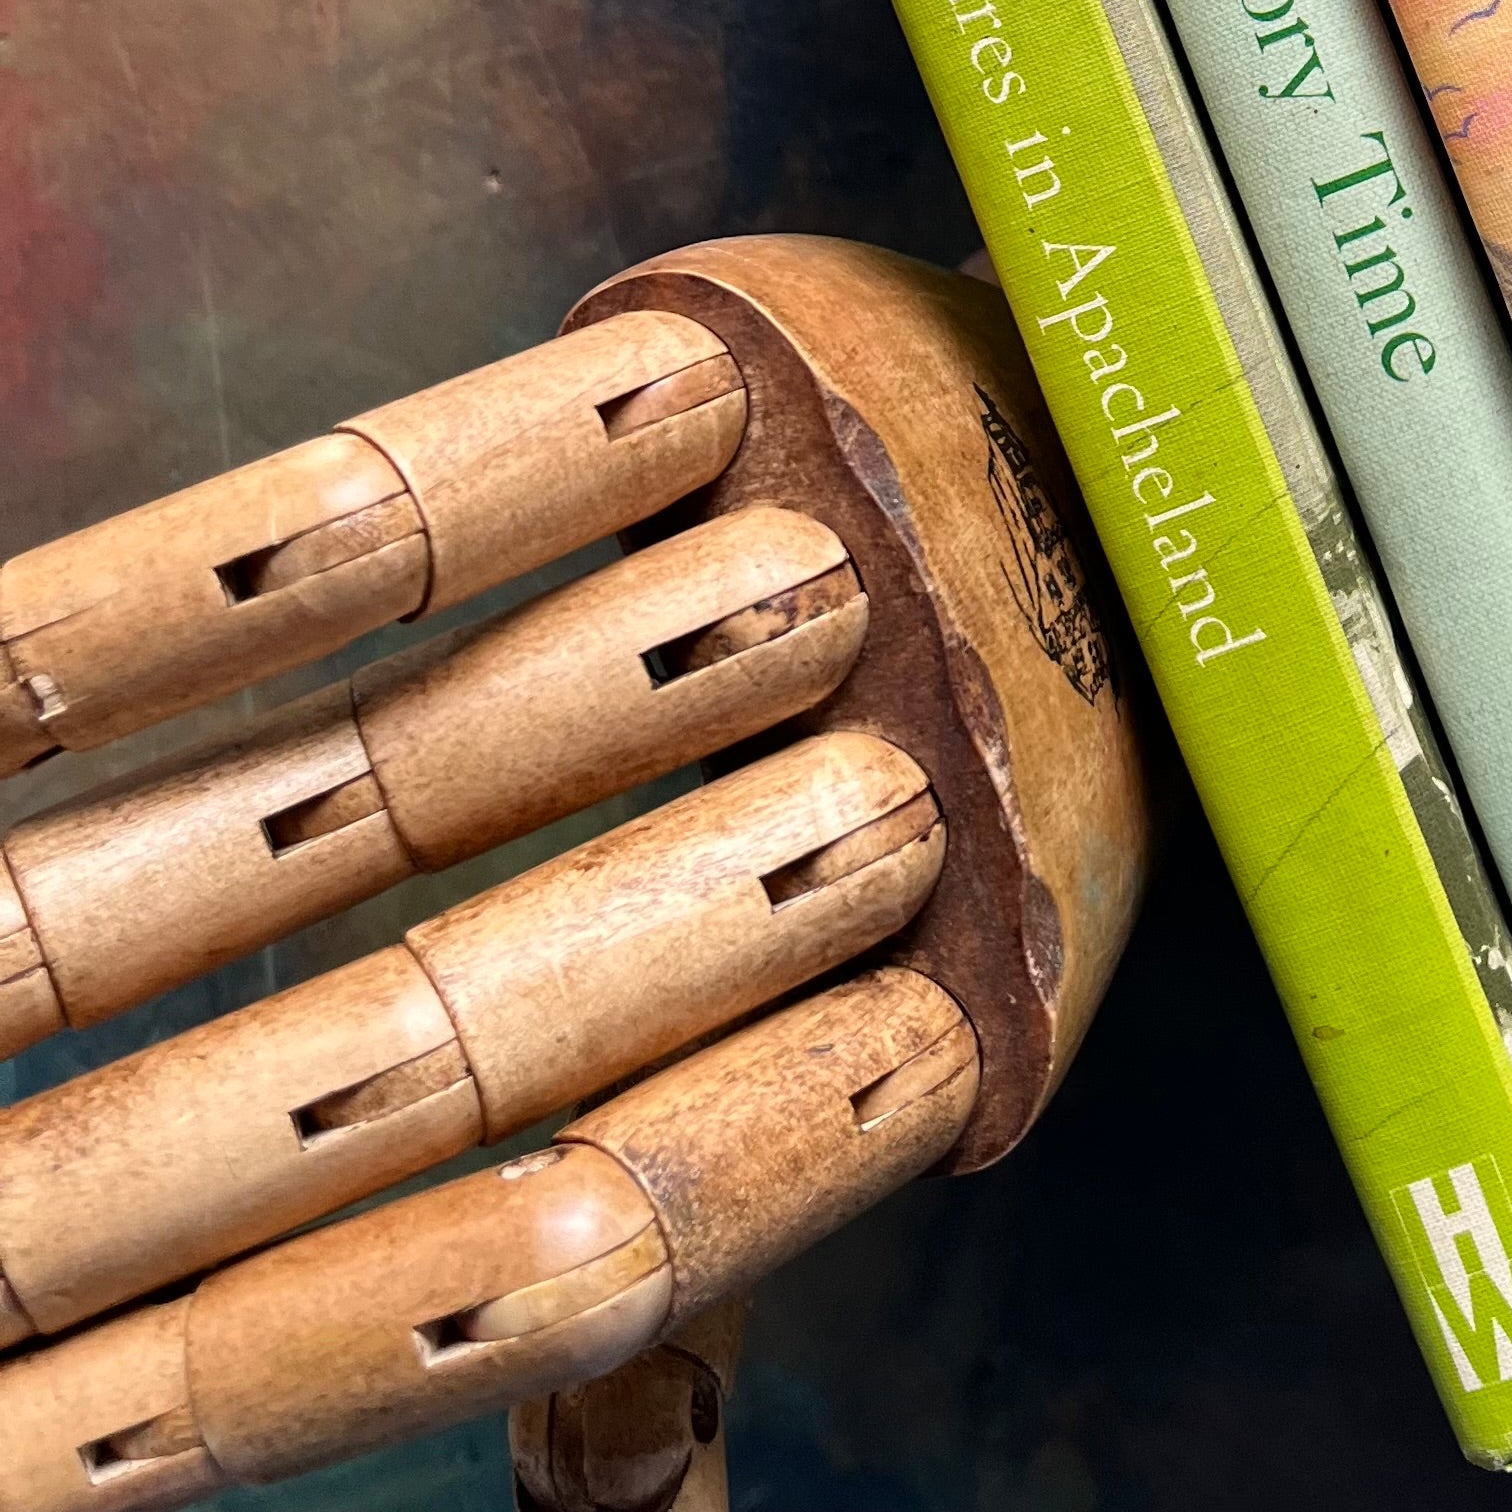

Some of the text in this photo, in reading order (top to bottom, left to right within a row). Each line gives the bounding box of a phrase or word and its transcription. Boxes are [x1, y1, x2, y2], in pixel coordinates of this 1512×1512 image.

[1005, 125, 1071, 212] in
[1311, 130, 1437, 382] Time
[1037, 238, 1268, 669] Apacheland
